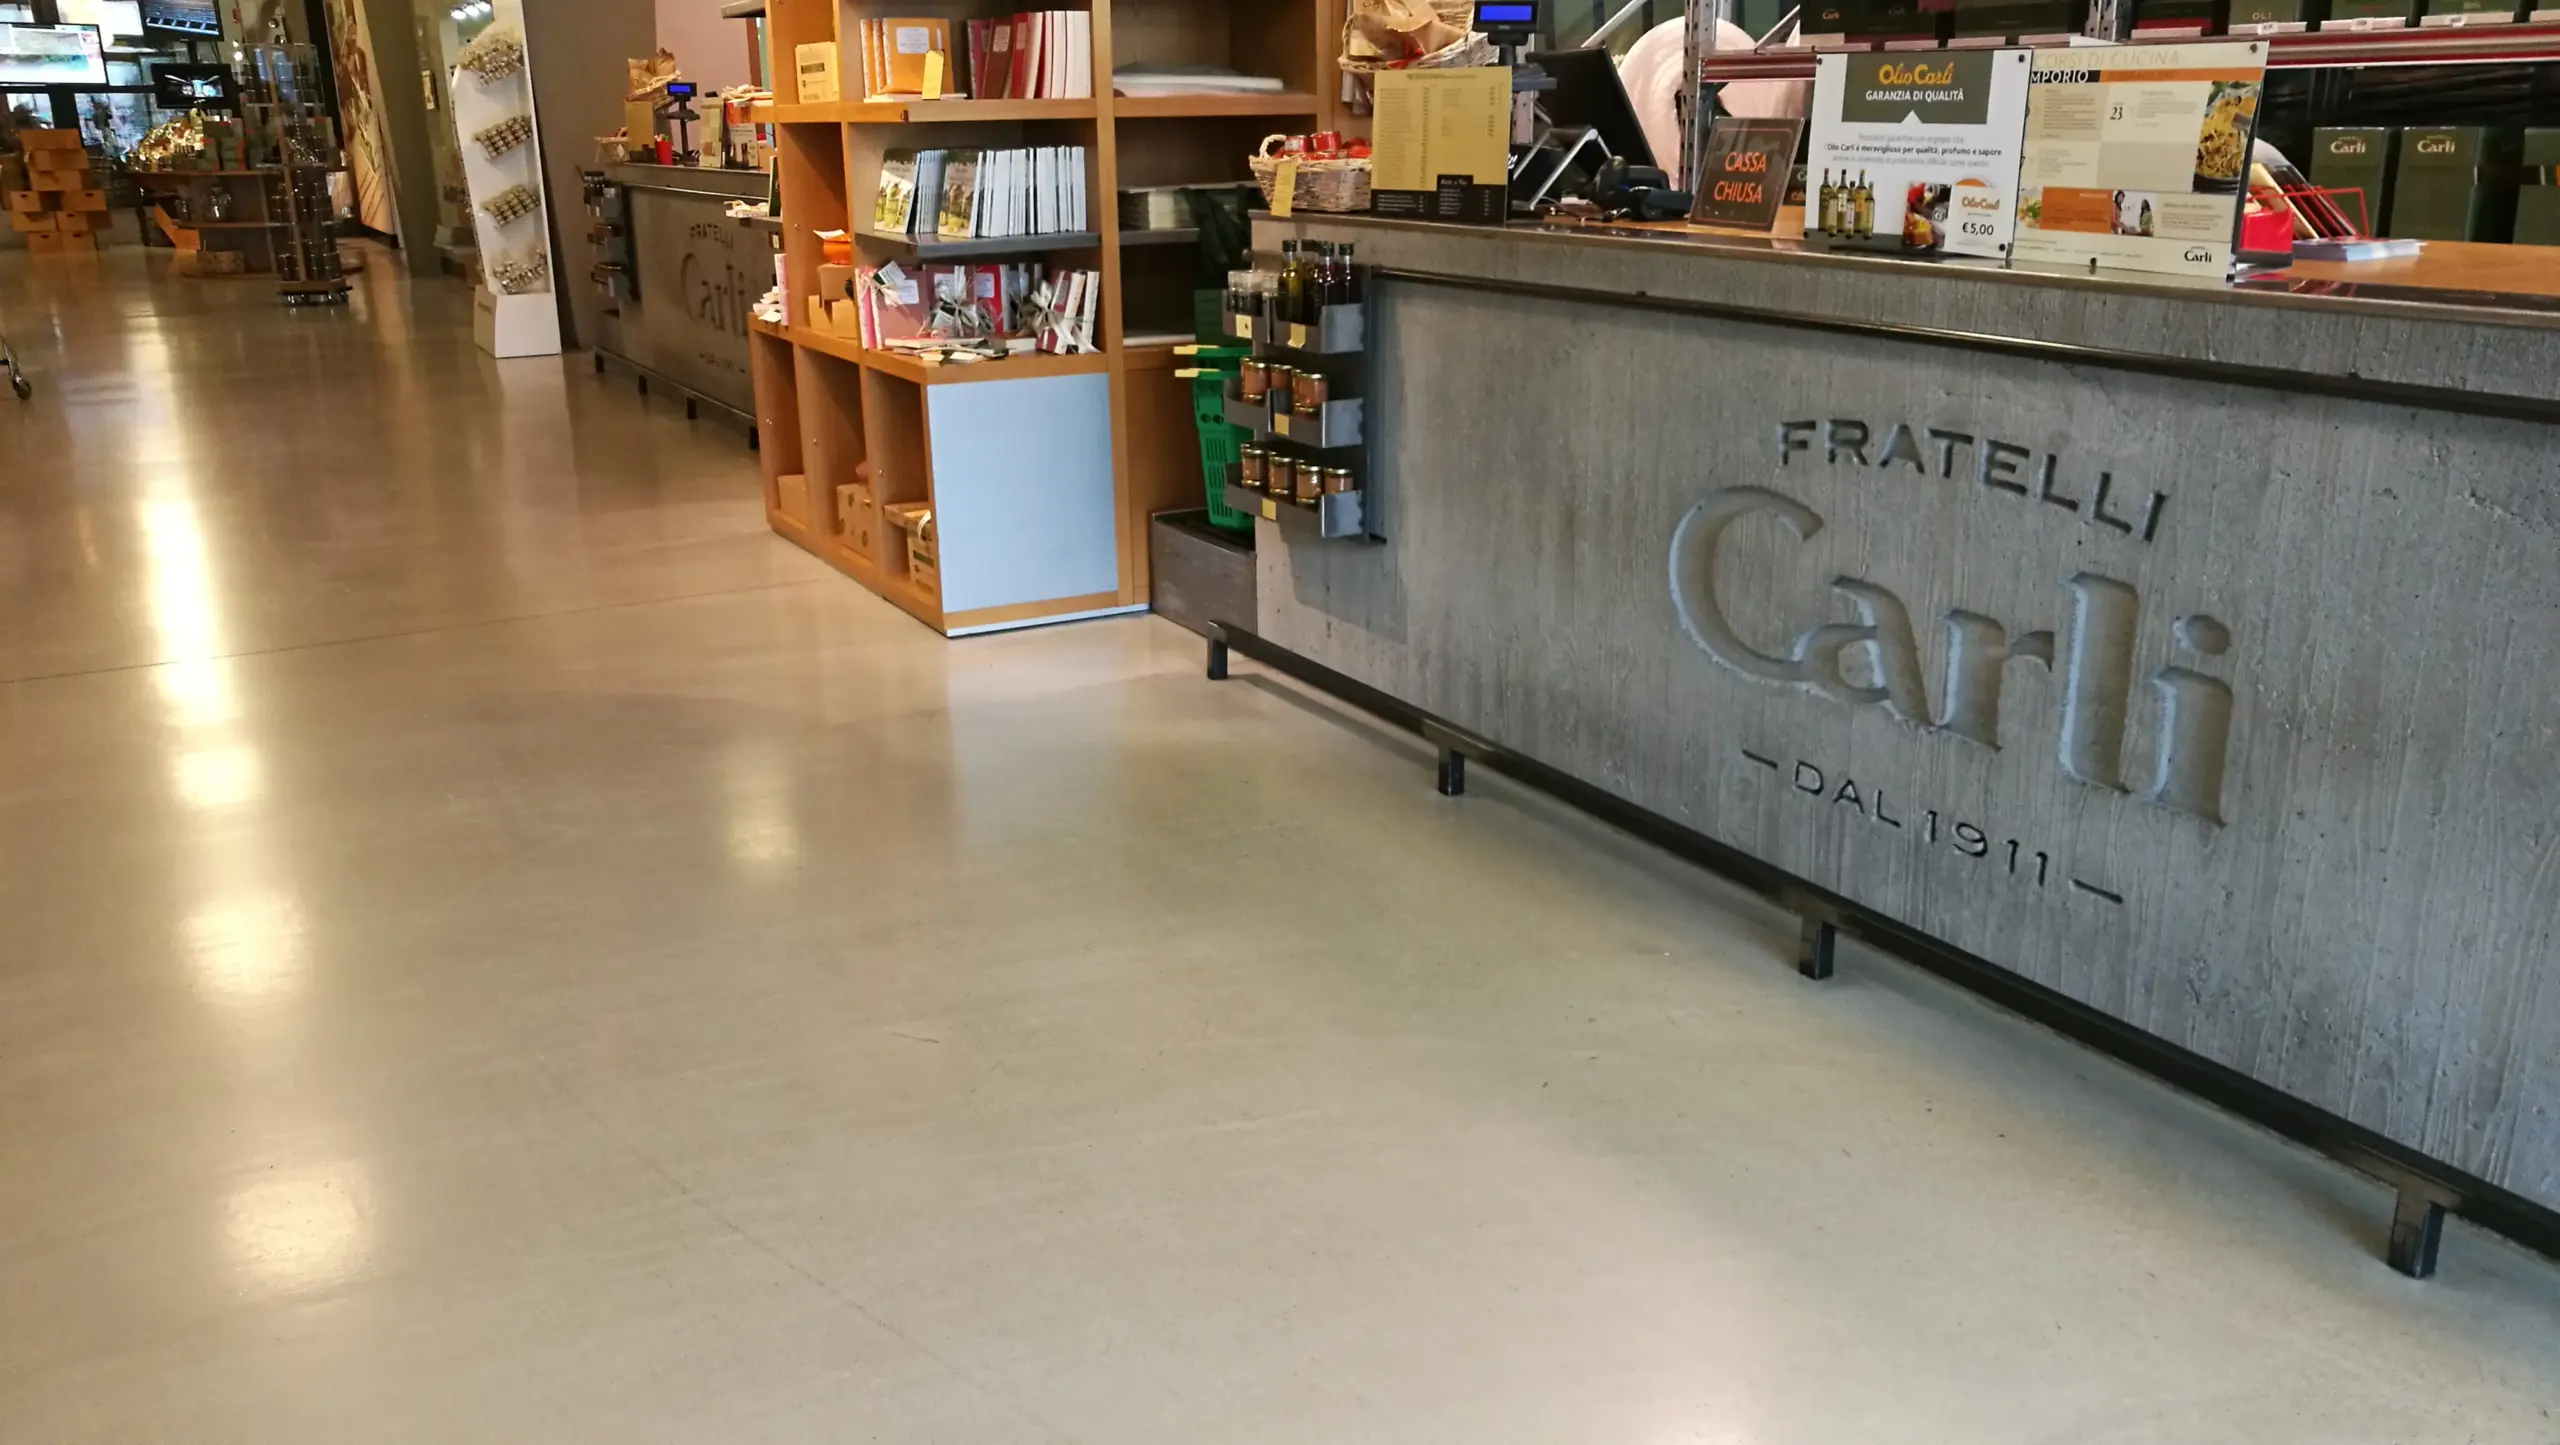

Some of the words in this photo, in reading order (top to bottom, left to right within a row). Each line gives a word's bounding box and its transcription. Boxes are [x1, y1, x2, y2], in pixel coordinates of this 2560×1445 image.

[2111, 50, 2179, 67] CUCINA
[2031, 70, 2089, 83] MPORIO
[1866, 90, 1911, 101] GARANZIA
[1913, 90, 1924, 101] DI
[1925, 88, 1964, 103] QUALITÀ
[1902, 147, 1914, 155] per
[1941, 146, 1971, 156] profumo
[1978, 149, 2002, 158] sapore
[2330, 141, 2366, 154] Carli
[2417, 140, 2455, 153] Carli
[1725, 152, 1767, 172] CASSA
[1714, 181, 1762, 204] CHIUSA
[1970, 222, 1994, 236] 5,00
[2184, 250, 2212, 263] Carli
[1775, 418, 2170, 542] FRATELLI
[1667, 484, 2234, 829] Carli
[1793, 759, 1901, 828] DAL
[1926, 809, 2049, 887] 1911
